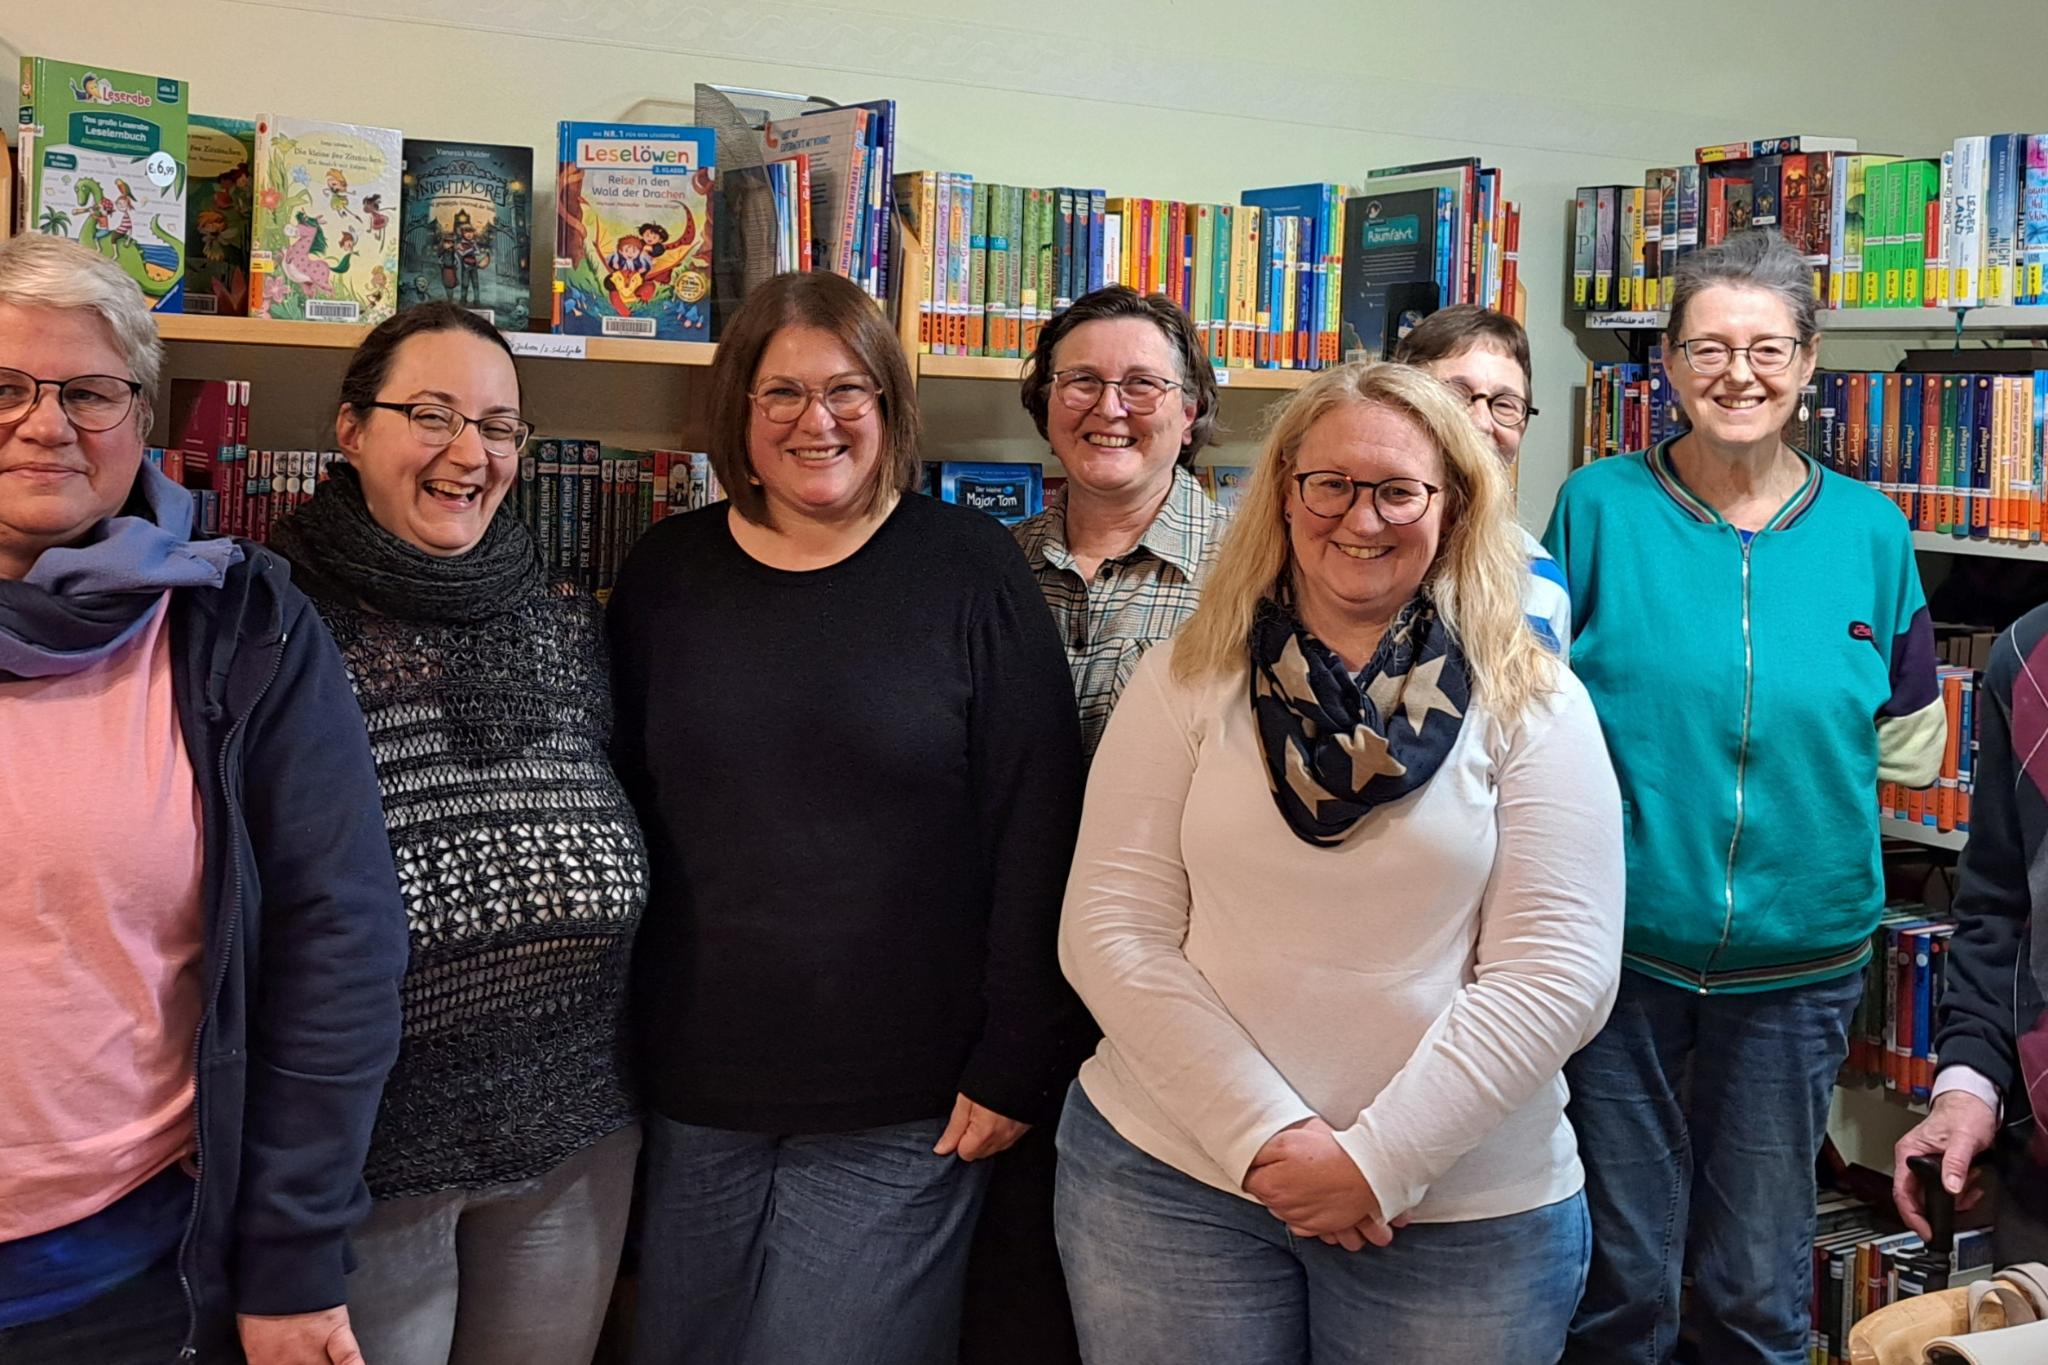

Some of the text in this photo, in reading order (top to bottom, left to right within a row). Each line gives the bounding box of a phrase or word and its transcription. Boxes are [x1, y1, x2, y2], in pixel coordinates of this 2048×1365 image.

[103, 87, 151, 106] Leserabe
[85, 125, 146, 142] Leselernbuch
[98, 117, 117, 128] große
[585, 145, 689, 163] Leselöwen
[1760, 140, 1780, 154] SPY
[420, 180, 502, 203] NIGHTMORE
[592, 187, 685, 199] Wald der Drachen
[608, 175, 670, 187] Reise in den
[847, 166, 859, 221] EXPERIMENTE
[1368, 227, 1413, 242] Raumfahrt
[1988, 227, 1999, 254] OHNE
[1998, 237, 2011, 266] NICHT
[1904, 424, 1918, 469] Zauberkugel
[1926, 425, 1938, 470] Zauberkugel
[1942, 426, 1953, 472] Zauberkugel
[1958, 426, 1969, 472] Zauberkugel
[1977, 427, 1989, 473] Zauberkugel
[540, 476, 550, 517] FLOHLING
[967, 493, 1017, 508] Major Tom
[562, 477, 571, 567] DER KLEINE FLOHLING
[580, 479, 592, 568] DER KLEINE FLOHLING
